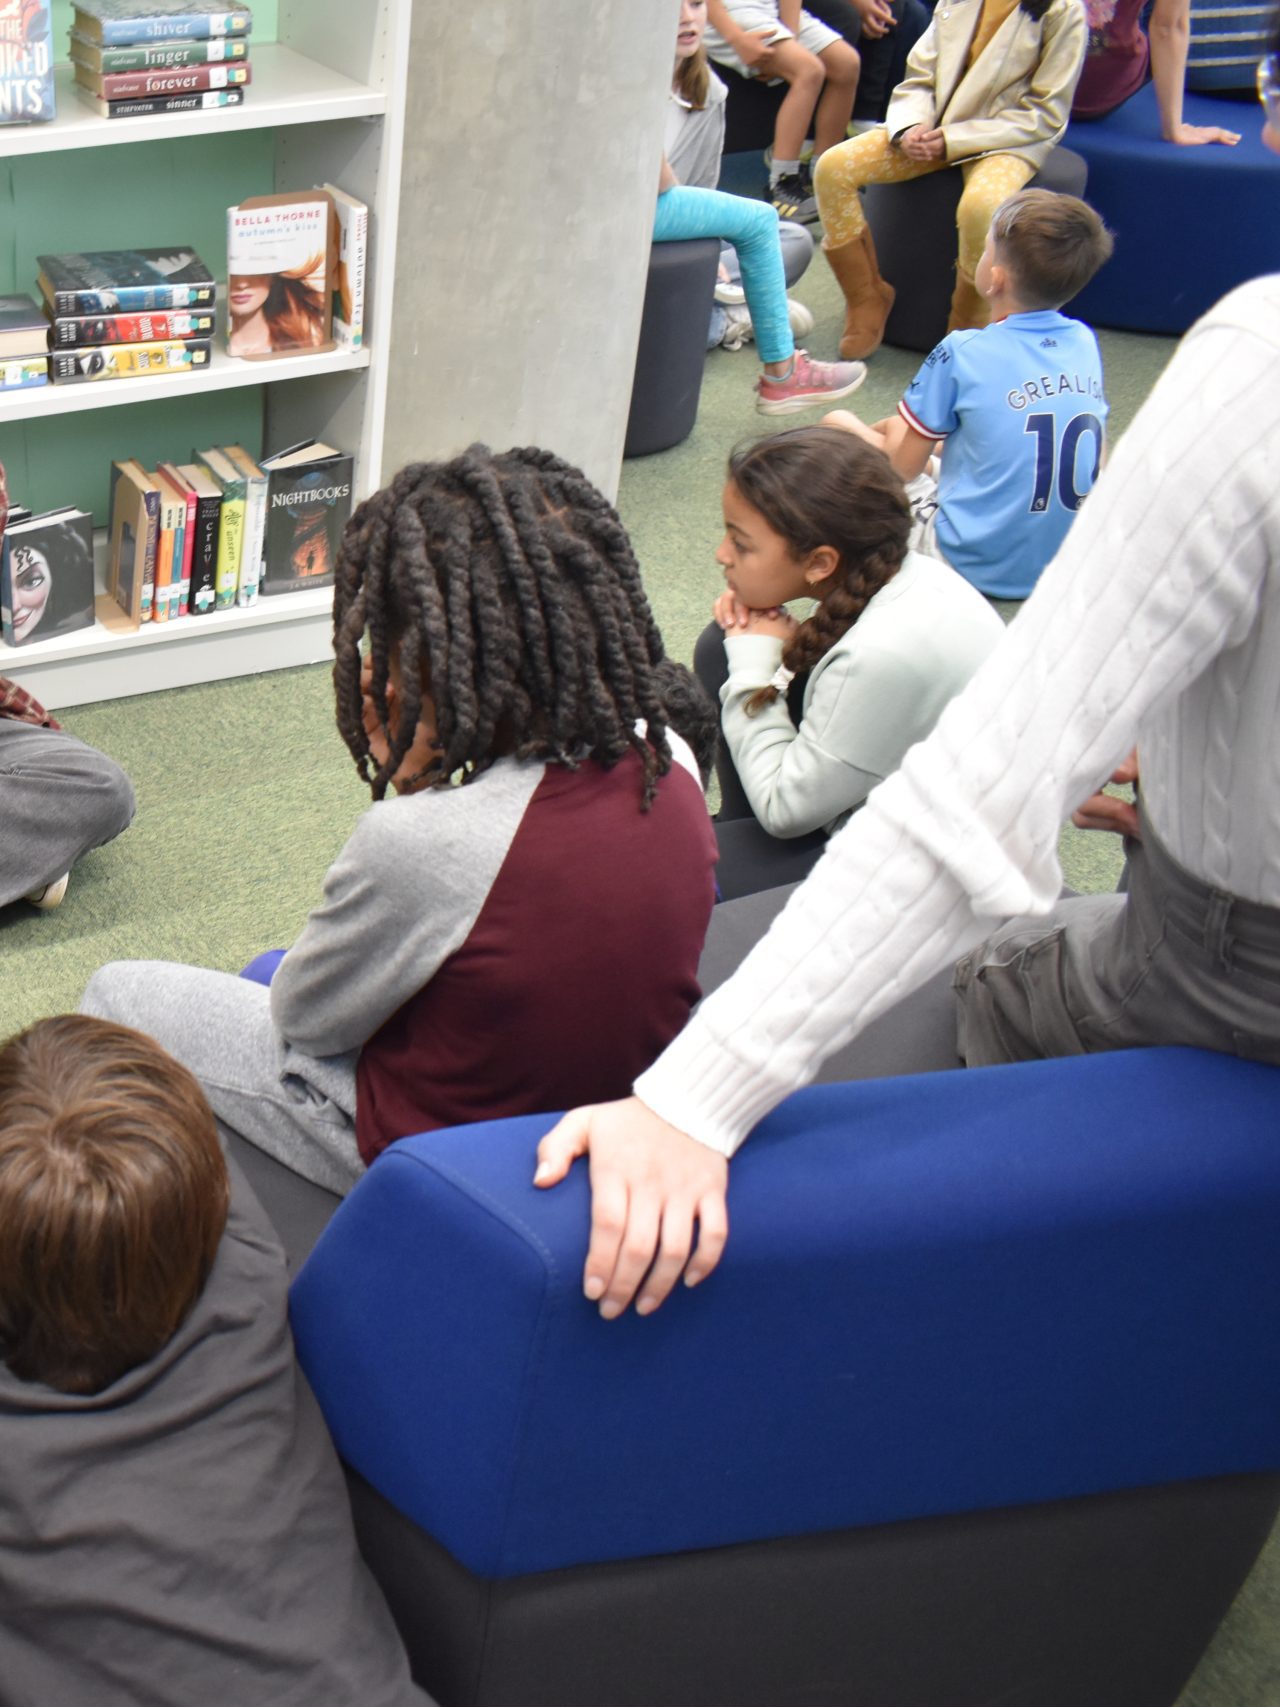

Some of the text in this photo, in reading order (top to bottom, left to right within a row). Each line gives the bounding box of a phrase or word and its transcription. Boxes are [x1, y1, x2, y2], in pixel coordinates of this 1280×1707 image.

[146, 22, 191, 37] shiver
[144, 50, 190, 65] linger
[146, 75, 199, 92] forever
[166, 98, 196, 110] sinner
[235, 210, 321, 226] BELLA THORNE
[1024, 412, 1106, 514] 10
[271, 484, 350, 508] NIGHTBOOKS
[226, 531, 235, 561] unseen
